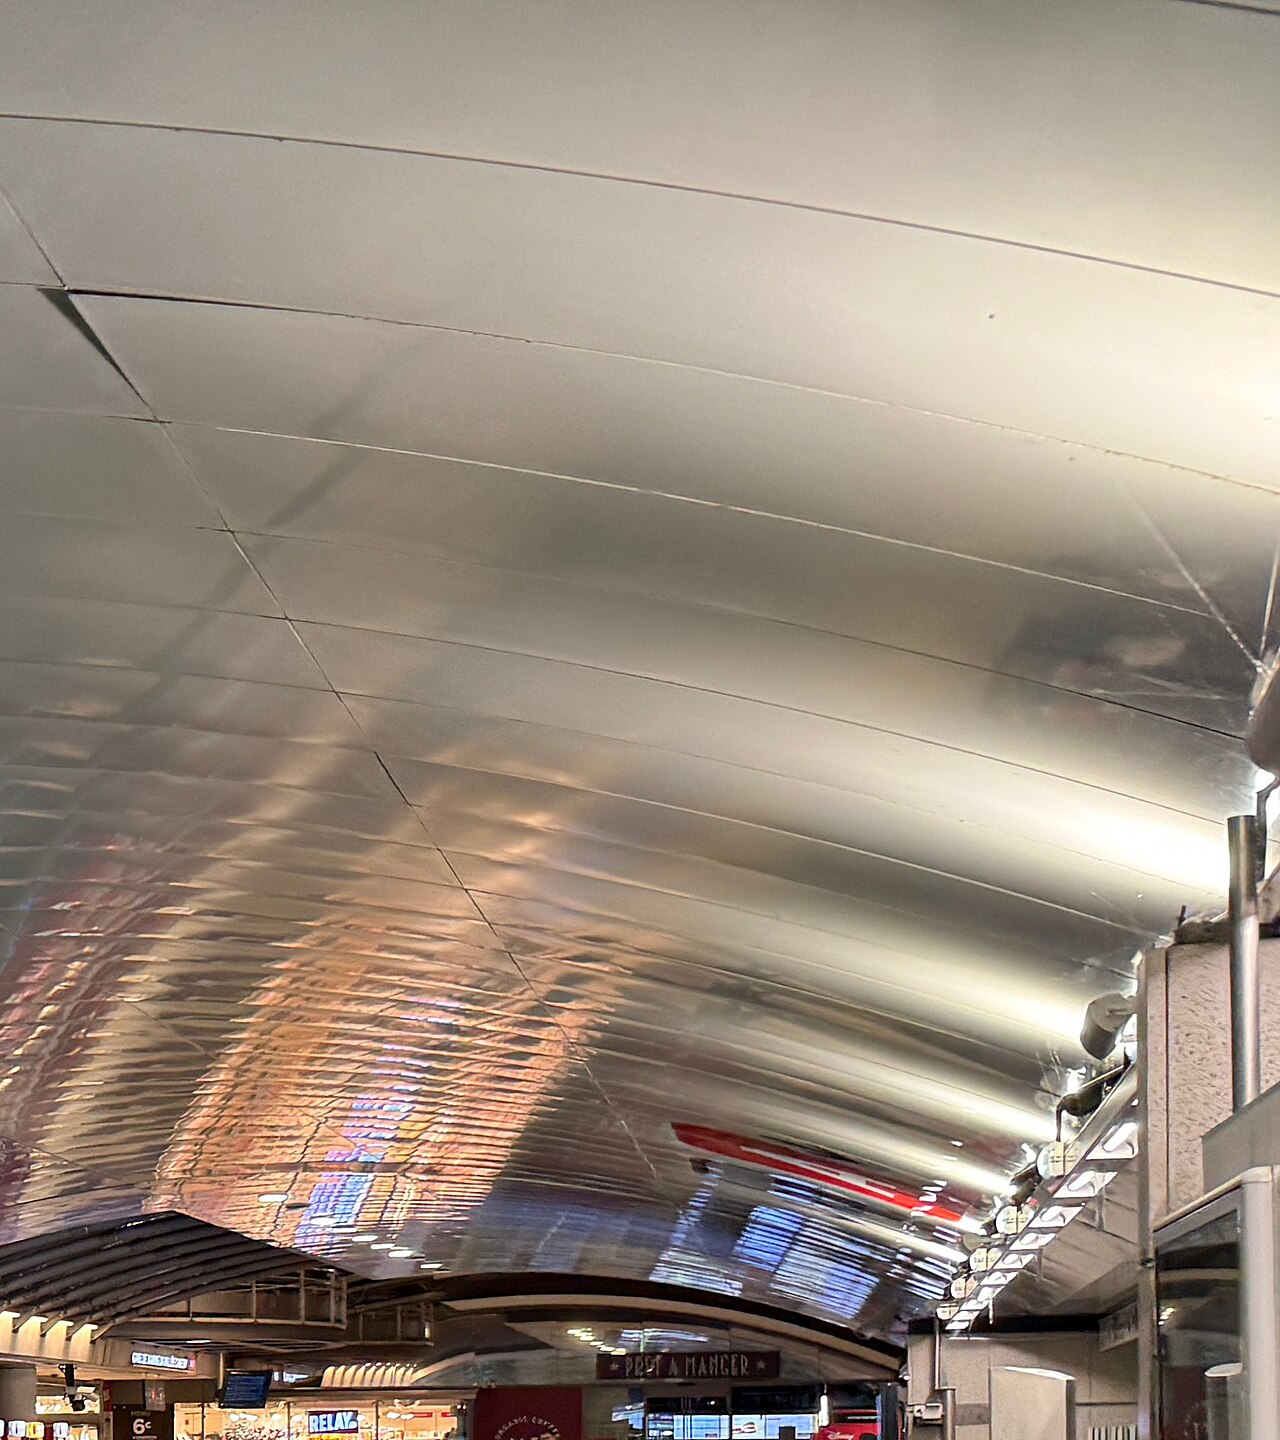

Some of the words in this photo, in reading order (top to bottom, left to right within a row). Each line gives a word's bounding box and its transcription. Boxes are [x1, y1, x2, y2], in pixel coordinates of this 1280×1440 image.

[669, 1355, 679, 1376] A
[685, 1354, 749, 1376] MANGER
[309, 1411, 352, 1432] RELAY
